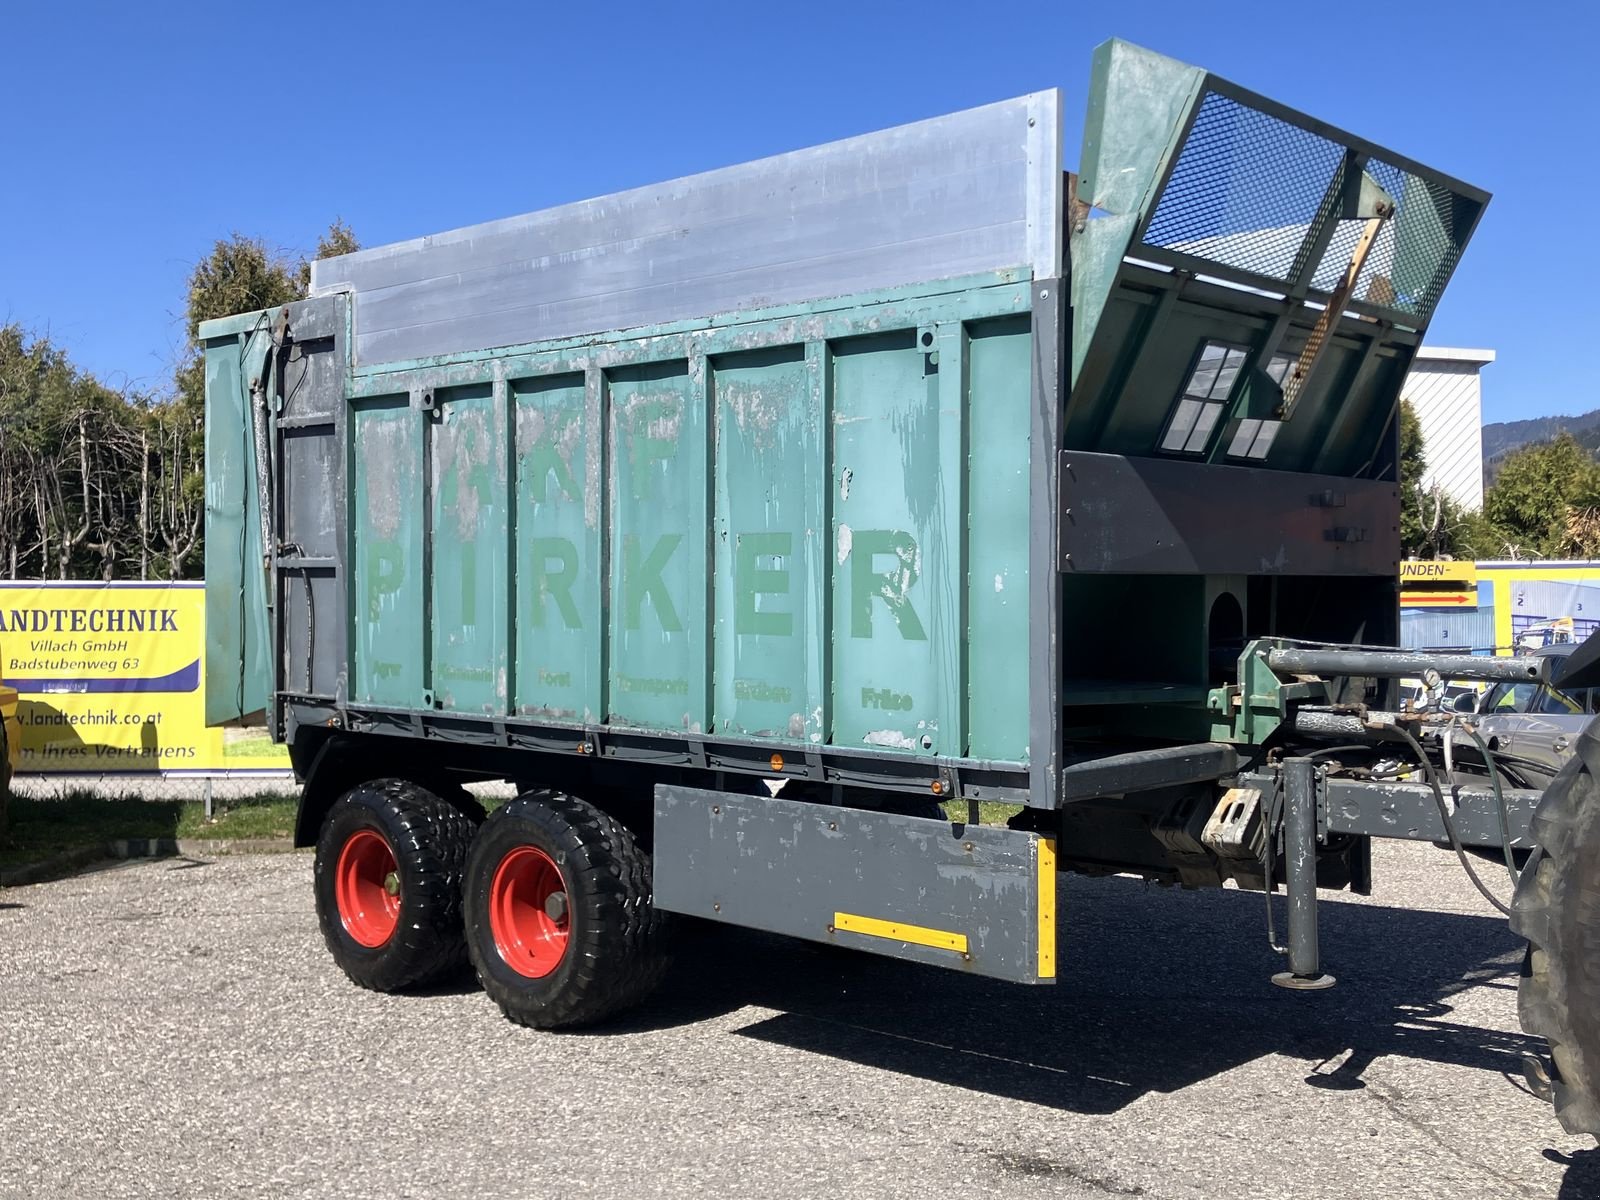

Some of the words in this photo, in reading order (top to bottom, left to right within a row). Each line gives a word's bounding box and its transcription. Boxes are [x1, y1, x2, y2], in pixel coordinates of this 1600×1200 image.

[367, 529, 928, 640] PIRKER
[30, 640, 78, 652] Villach
[83, 640, 128, 652] GmbH
[9, 658, 118, 671] Badstubenweg
[122, 658, 140, 669] 63
[41, 743, 87, 759] Ihres
[95, 743, 196, 759] Vertrauens
